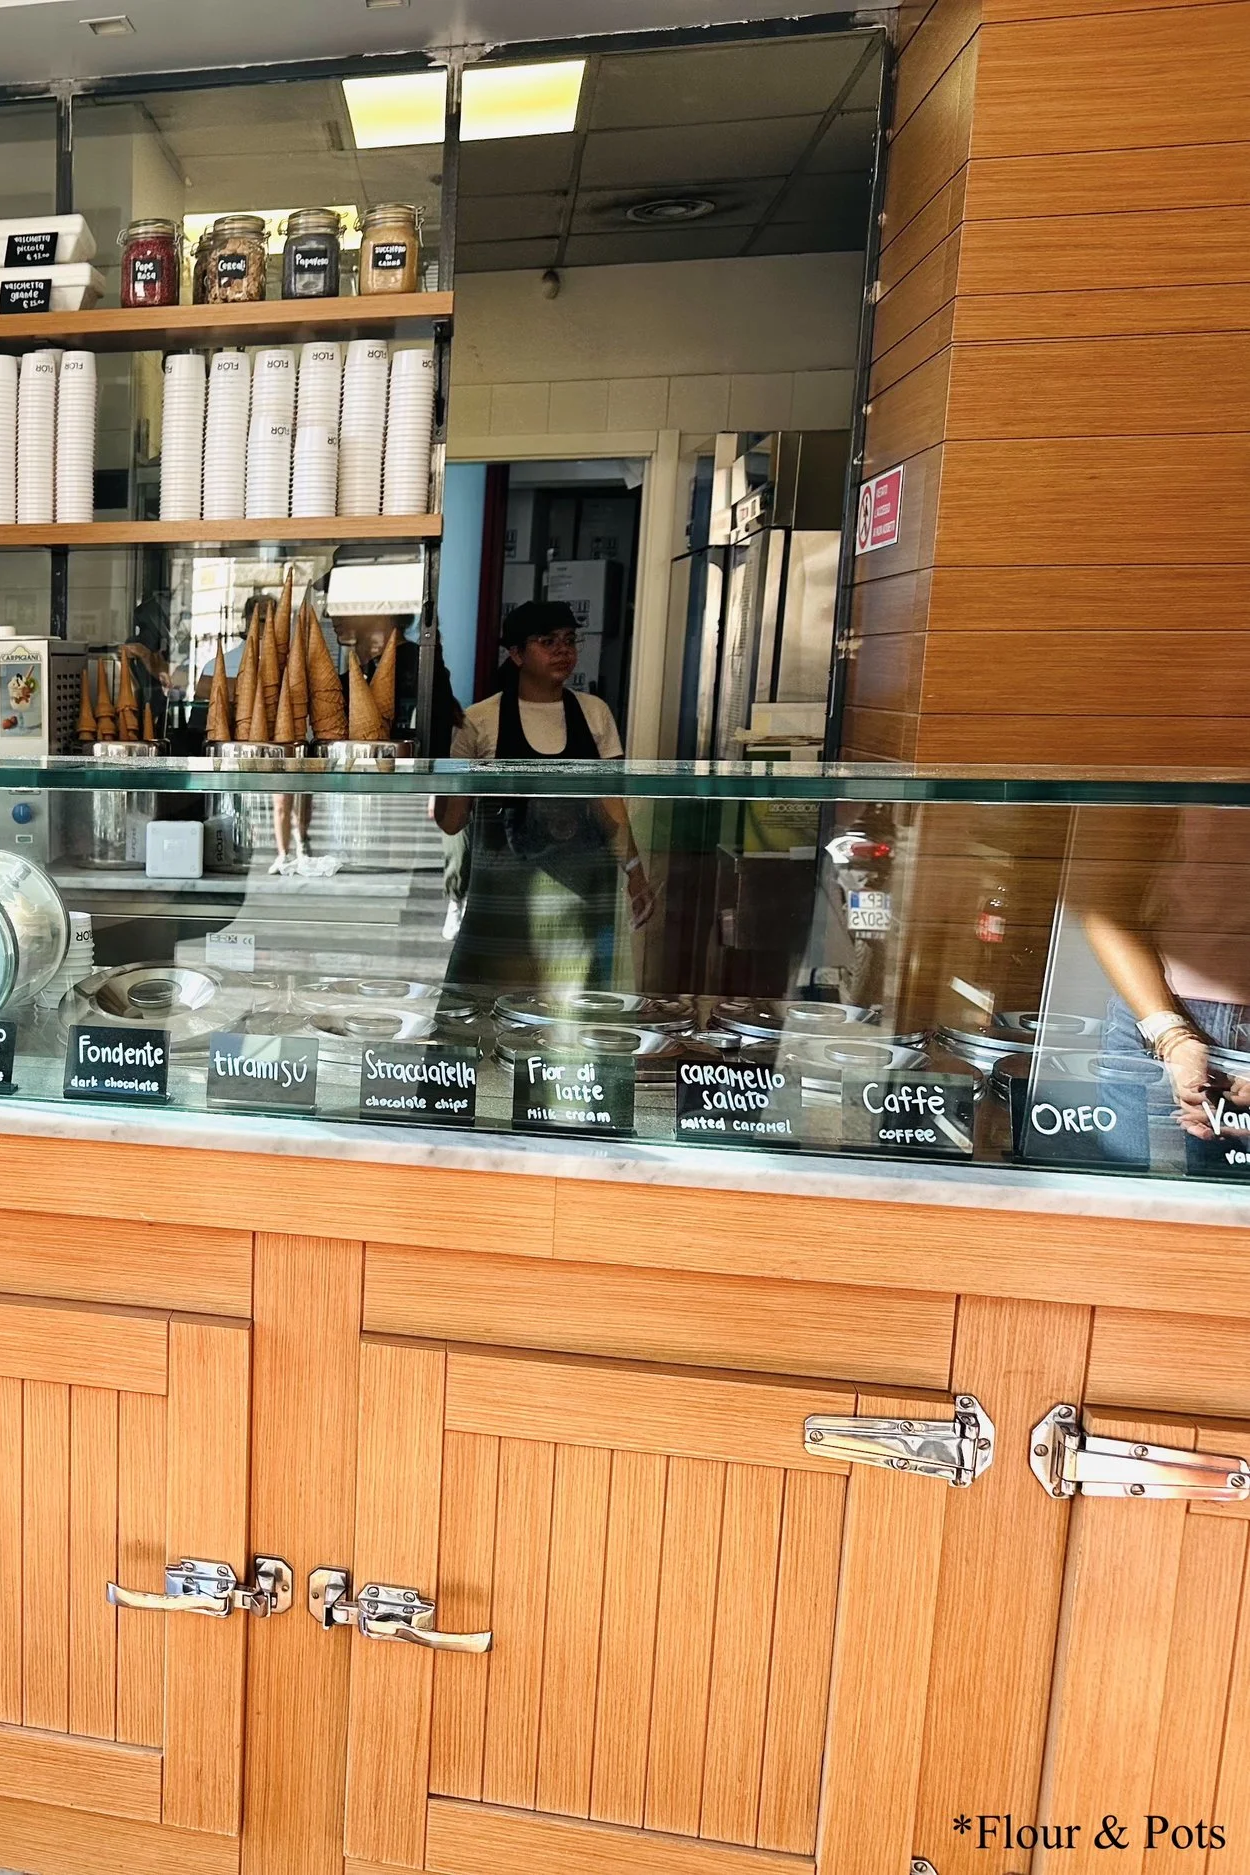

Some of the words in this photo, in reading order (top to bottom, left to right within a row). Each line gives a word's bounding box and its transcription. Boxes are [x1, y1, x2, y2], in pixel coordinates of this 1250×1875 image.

[267, 360, 289, 368] FLOR
[312, 352, 334, 360] FLOR
[64, 362, 83, 370] FLOR
[217, 362, 238, 370] FLOR
[78, 1035, 164, 1067] Fondente
[365, 1049, 476, 1088] Stracciatella
[527, 1056, 565, 1084] Fior
[577, 1063, 595, 1082] di
[71, 1075, 98, 1088] dark
[105, 1078, 159, 1092] chocolate
[555, 1083, 605, 1102] latte
[365, 1095, 427, 1109] chocolate
[434, 1097, 468, 1113] chips
[862, 1082, 946, 1117] Caffè
[565, 1110, 611, 1123] cream
[680, 1117, 726, 1131] salted
[1031, 1102, 1118, 1136] OREO
[1202, 1098, 1250, 1135] Van
